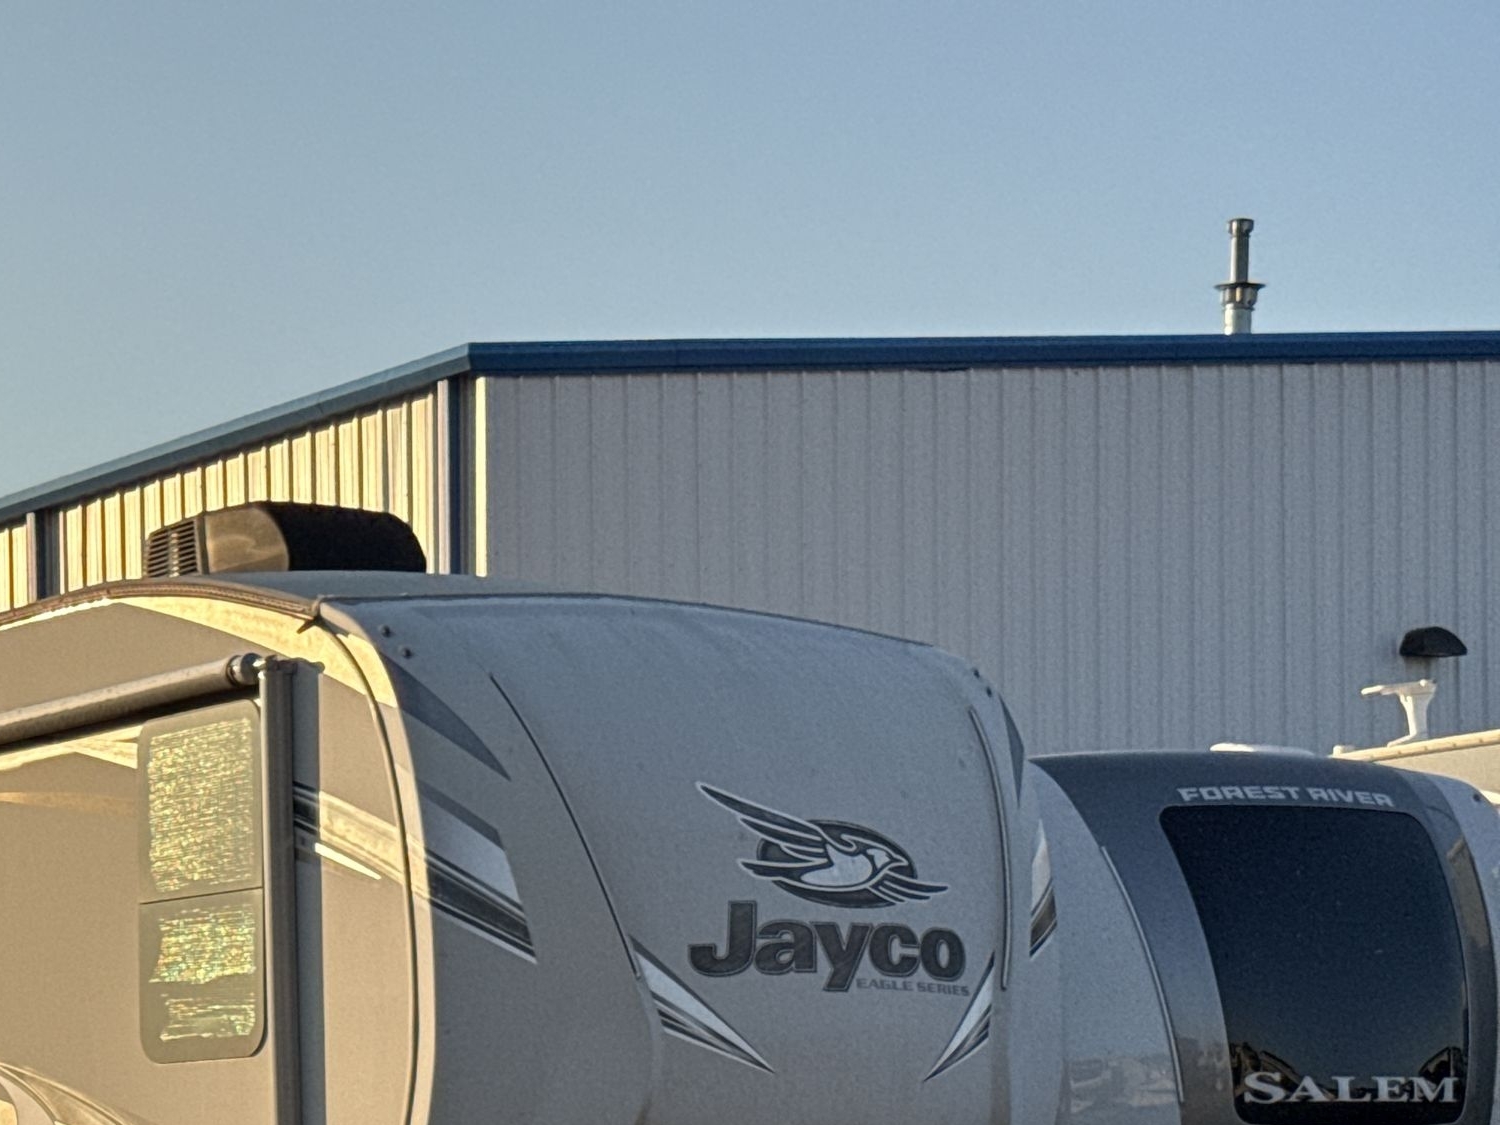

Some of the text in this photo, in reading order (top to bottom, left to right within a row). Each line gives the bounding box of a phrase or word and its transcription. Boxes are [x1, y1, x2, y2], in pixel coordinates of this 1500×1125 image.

[1177, 786, 1394, 807] FOREST RIVER
[688, 900, 967, 992] Jayco
[856, 979, 970, 997] EAGLE SERIES
[1243, 1071, 1459, 1104] SALEM
